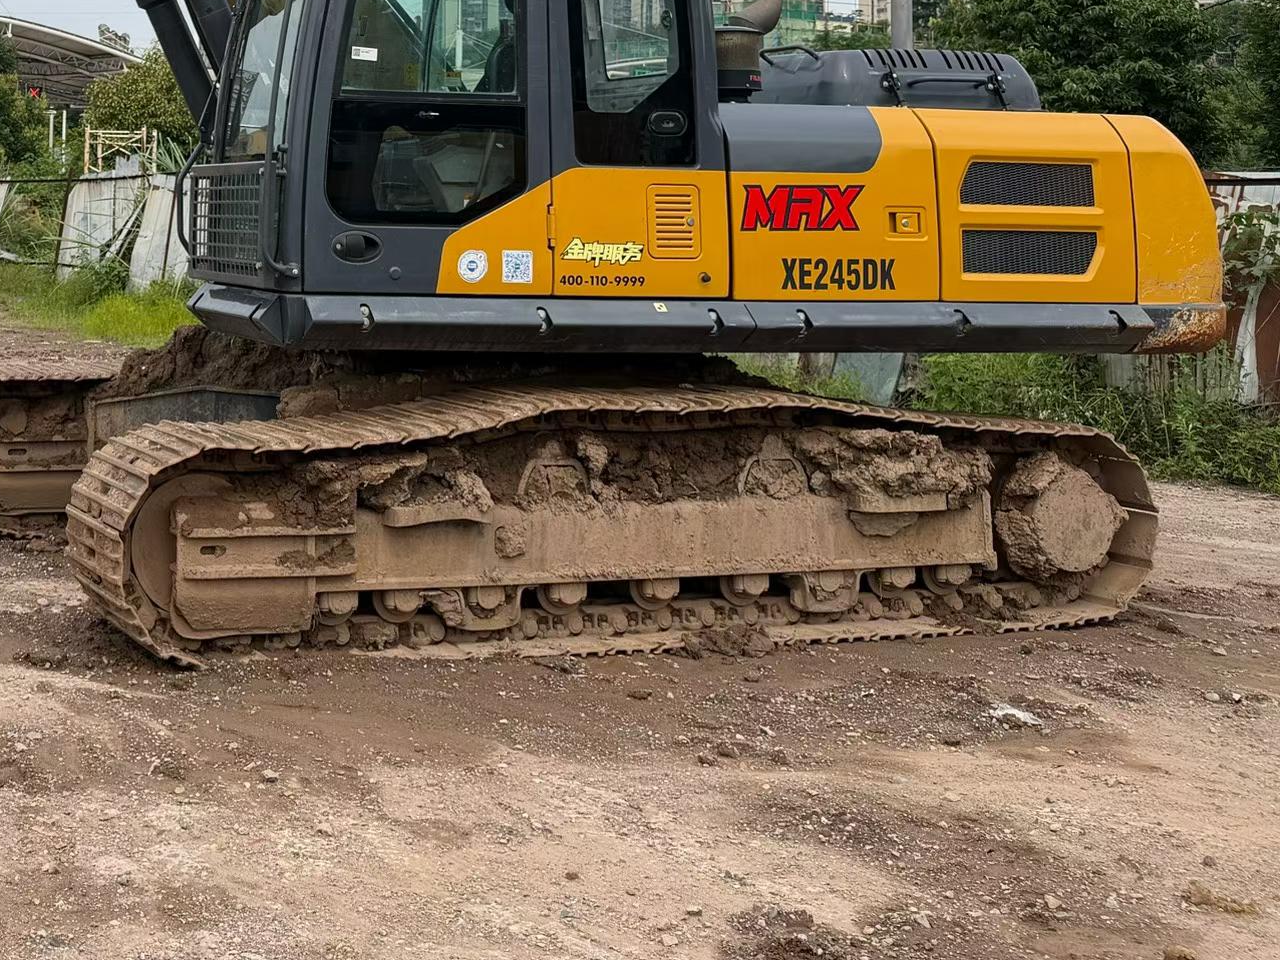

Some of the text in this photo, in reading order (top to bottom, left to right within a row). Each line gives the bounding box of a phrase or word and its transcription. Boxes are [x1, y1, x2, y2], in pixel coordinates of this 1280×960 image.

[740, 184, 865, 232] MAX
[560, 238, 645, 268] 金牌服务
[559, 275, 646, 287] 400-110-9999
[781, 258, 896, 292] XE245DK
